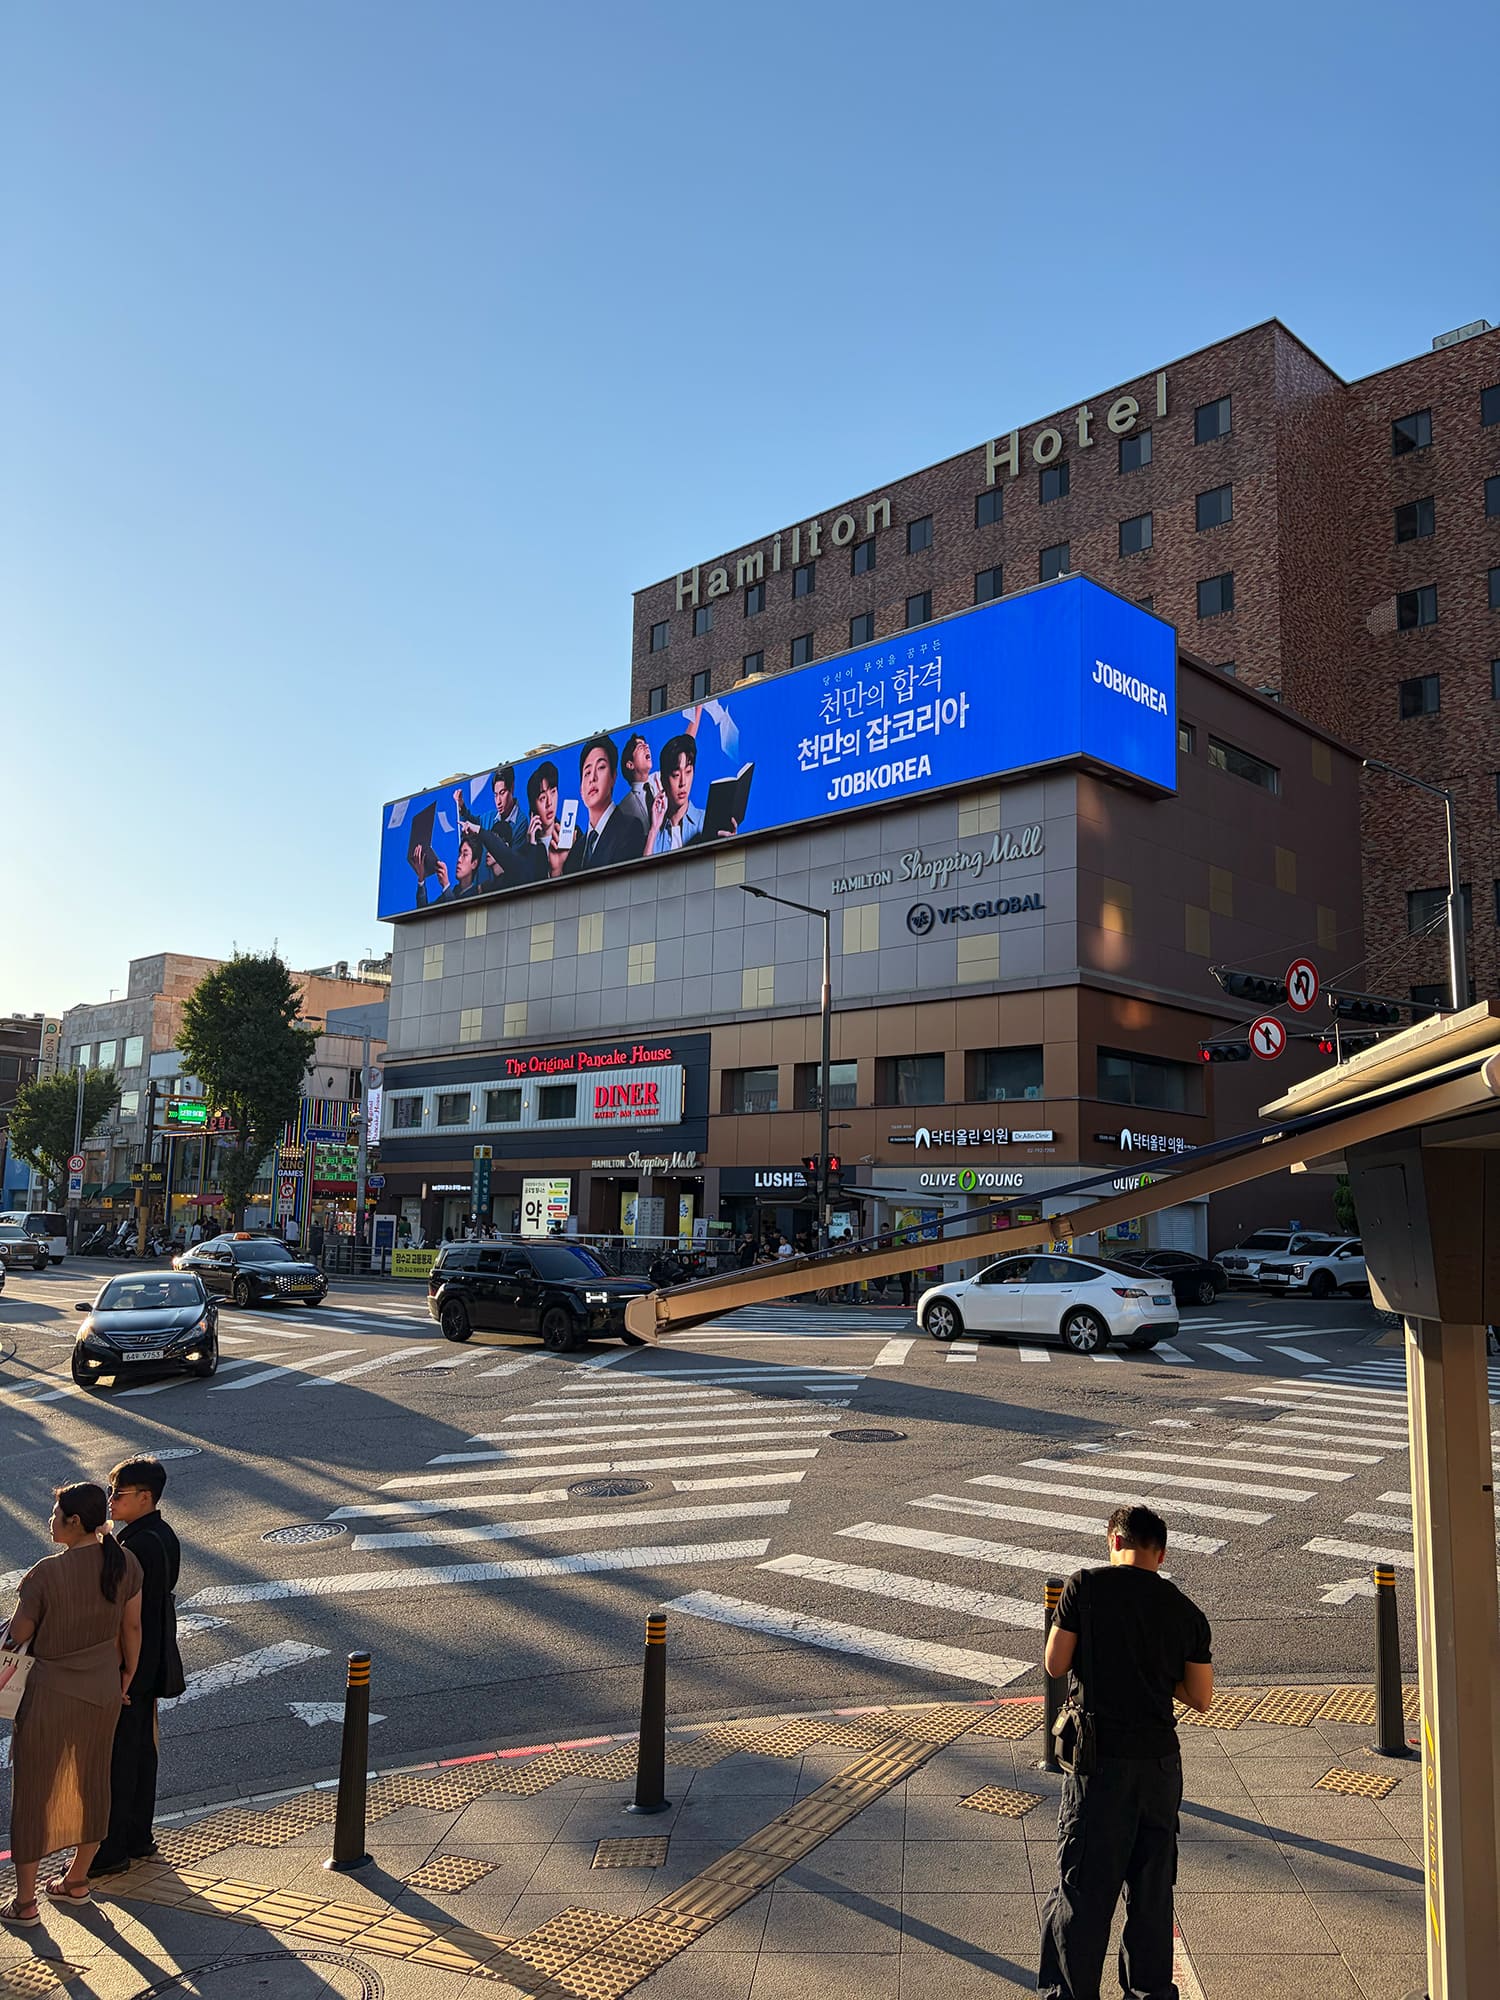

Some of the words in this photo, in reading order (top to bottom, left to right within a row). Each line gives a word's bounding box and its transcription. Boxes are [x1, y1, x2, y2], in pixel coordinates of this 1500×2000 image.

[675, 496, 892, 612] Hamilton
[985, 371, 1169, 486] Hotel
[822, 667, 854, 685] 당신이
[863, 653, 897, 673] 무엇을
[818, 679, 886, 725] 천만의
[891, 655, 944, 703] 합격
[1092, 659, 1168, 716] JOBKOREA
[796, 727, 861, 772] 천만의
[866, 691, 970, 752] 잡코리아
[827, 754, 932, 801] JOBKOREA
[831, 869, 892, 895] HAMILTON
[897, 848, 983, 889] Shopping
[982, 825, 1045, 868] Mall
[937, 893, 1045, 926] VFS.GLOBAL
[505, 1057, 527, 1078] The
[528, 1053, 575, 1075] Original
[578, 1049, 627, 1069] Pancake
[629, 1045, 672, 1065] House
[594, 1081, 659, 1109] DINER
[931, 1127, 980, 1146] 닥터올린
[983, 1127, 1009, 1145] 의원
[1132, 1132, 1166, 1152] 닥터올린
[1168, 1136, 1184, 1153] 의원
[71, 1159, 82, 1168] 50
[278, 1161, 304, 1169] KING
[592, 1159, 626, 1169] HAMILTON
[627, 1150, 669, 1176] Shopping
[668, 1150, 697, 1169] Mall
[755, 1172, 793, 1187] LUSH
[920, 1174, 957, 1186] OLIVE
[977, 1173, 1024, 1187] YOUNG
[526, 1200, 542, 1229] 약
